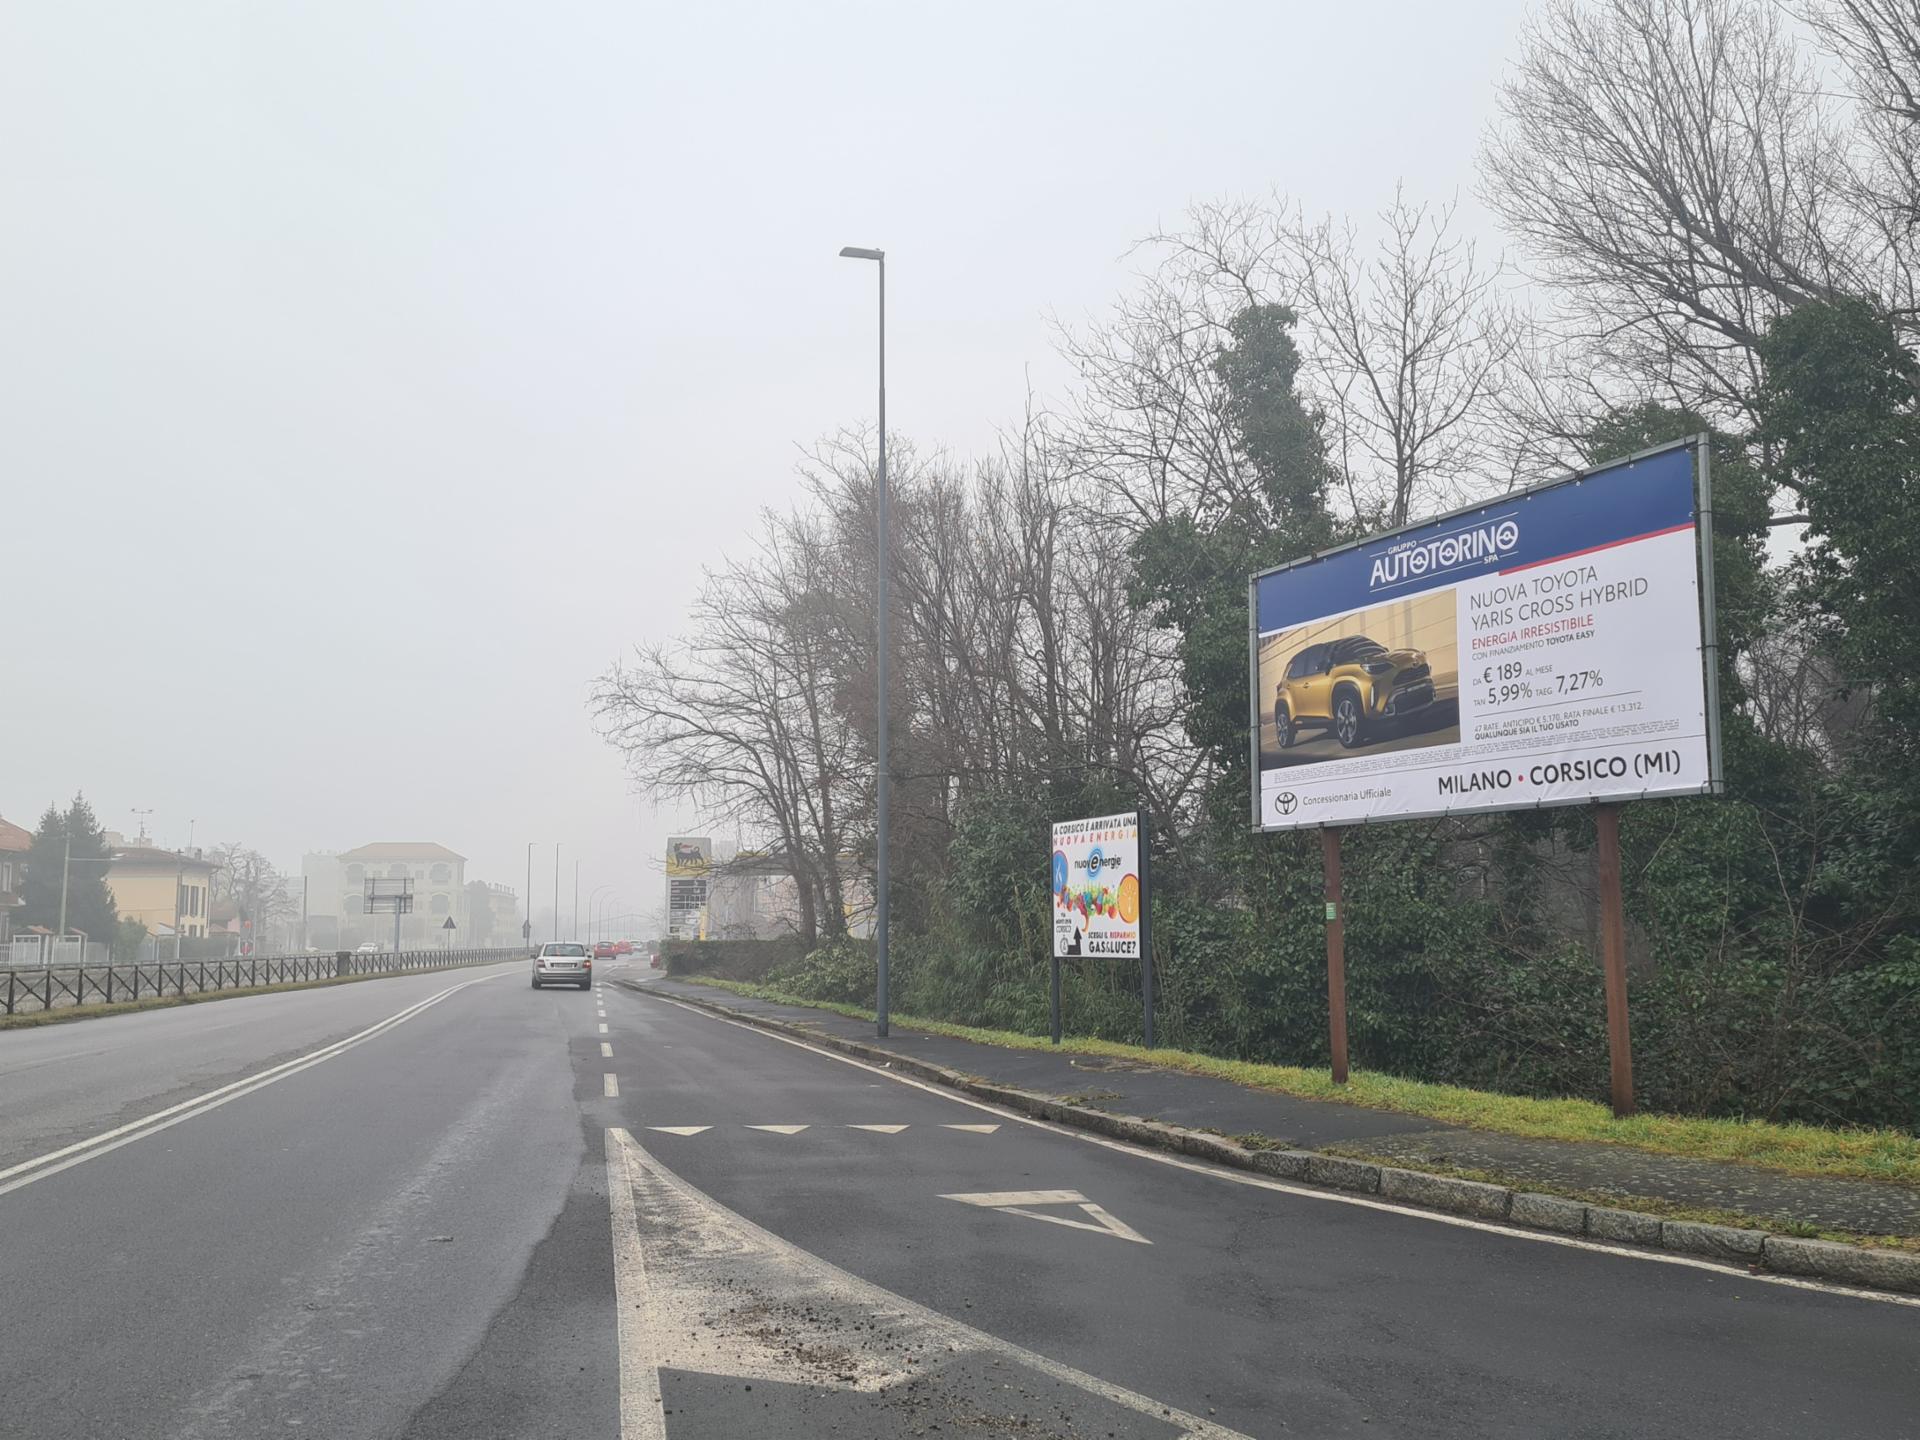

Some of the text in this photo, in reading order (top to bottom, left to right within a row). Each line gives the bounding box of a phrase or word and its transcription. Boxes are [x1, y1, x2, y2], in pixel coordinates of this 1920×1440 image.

[1370, 521, 1519, 586] AUTOTORINO
[1387, 540, 1417, 555] GRUPPO
[1483, 554, 1499, 565] SPA
[1470, 565, 1598, 610] NUOVA TOYOTA
[1471, 577, 1648, 631] YARIS CROSS HYBRID
[1472, 614, 1594, 650] ENERGIA IRRESISTIBILE
[1472, 630, 1595, 661] CON FINANZIAMENTO TOYOTA EASY
[1472, 661, 1553, 686] DA € 189 AL MESE
[1474, 669, 1603, 706] TAN 5,99% TAEG 7,27%
[1502, 717, 1535, 729] ANTICIPO
[1563, 710, 1581, 720] RATA
[1582, 706, 1609, 717] FINALE
[1475, 719, 1579, 741] QUALUNQUE SIA IL TUO USATO
[1438, 769, 1512, 795] MILANO
[1530, 756, 1627, 786] CORSICO
[1634, 750, 1681, 779] (MI)
[1303, 787, 1392, 806] Concessionaria Ufficiale
[1053, 829, 1137, 846] NUOVA ENERGIA
[1059, 823, 1085, 835] CORSICO
[1090, 819, 1121, 831] ARRIVATA
[1123, 816, 1137, 827] UNA
[1109, 931, 1137, 940] RISPARMIO
